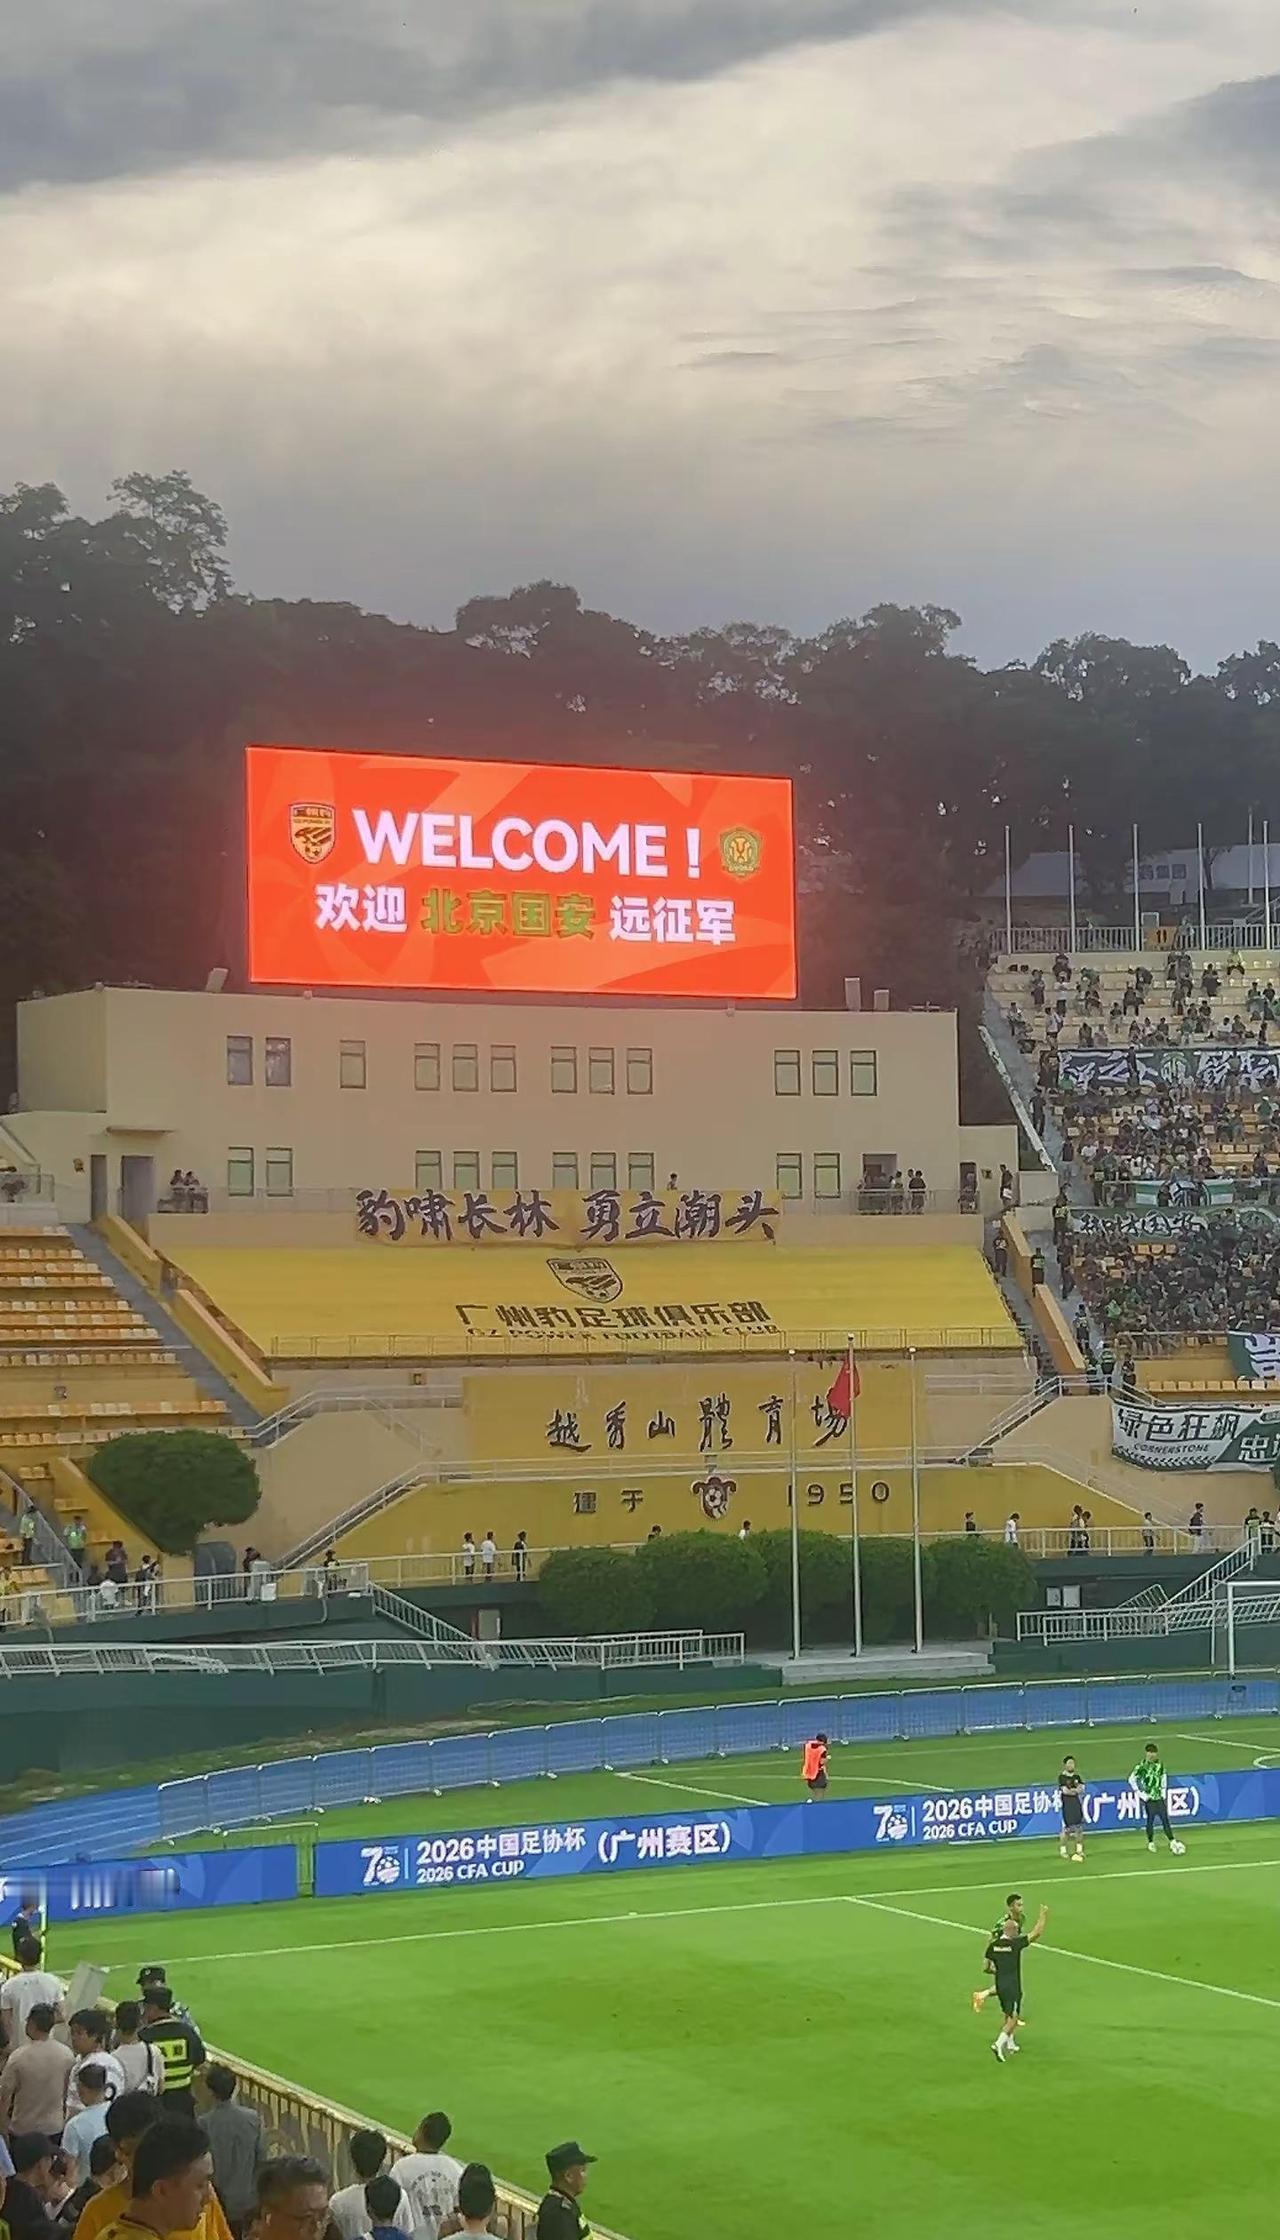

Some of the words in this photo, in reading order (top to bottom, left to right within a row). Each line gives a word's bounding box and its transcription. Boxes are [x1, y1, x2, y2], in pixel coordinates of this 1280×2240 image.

[352, 808, 668, 878] WELCOME
[314, 883, 408, 934] 欢迎
[419, 887, 596, 941] 北京国安
[609, 895, 737, 946] 远征军
[577, 1188, 780, 1244] 勇立潮头
[455, 1301, 772, 1329] 广州豹足球俱乐部
[1083, 1786, 1199, 1823] (广州区)
[923, 1821, 955, 1841] 2026
[958, 1822, 986, 1836] CFA
[988, 1819, 1018, 1835] CUP
[417, 1867, 454, 1884] 2026
[457, 1864, 489, 1881] CFA
[493, 1860, 525, 1877] CUP
